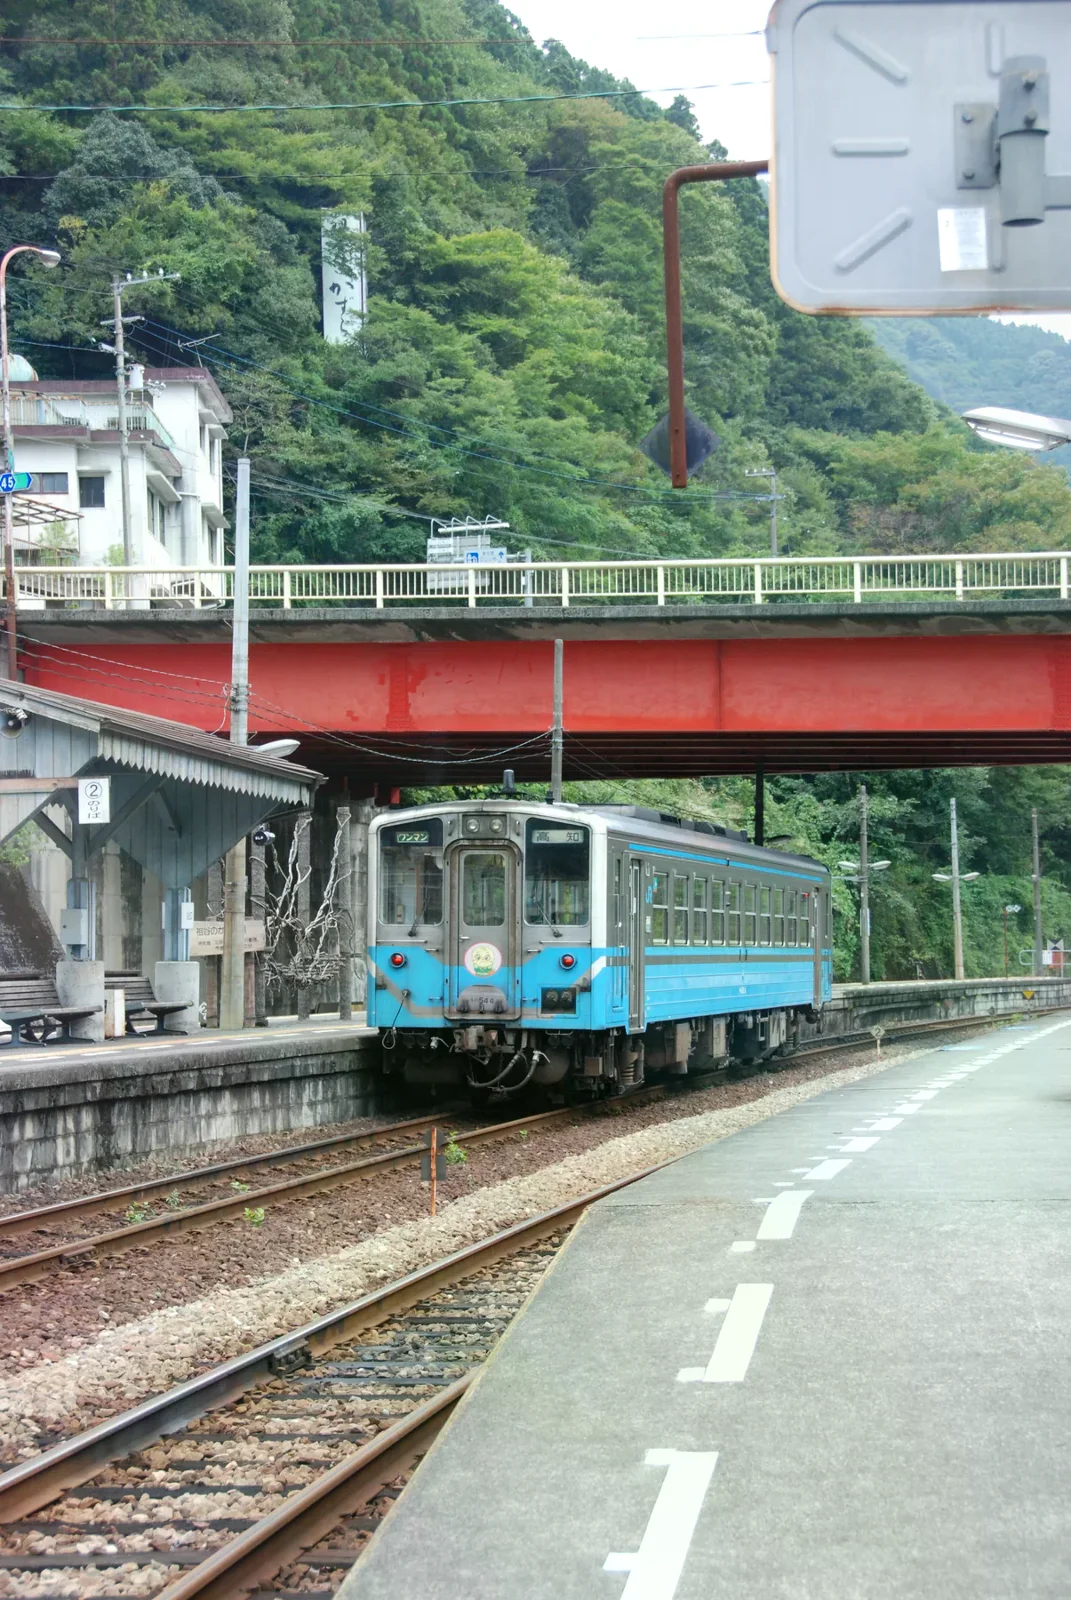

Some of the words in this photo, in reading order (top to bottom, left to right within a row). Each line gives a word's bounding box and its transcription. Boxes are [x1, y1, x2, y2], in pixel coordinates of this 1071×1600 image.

[1, 477, 14, 489] 45
[87, 801, 100, 819] のりば
[398, 833, 428, 842] ワンマン
[645, 885, 653, 904] JR
